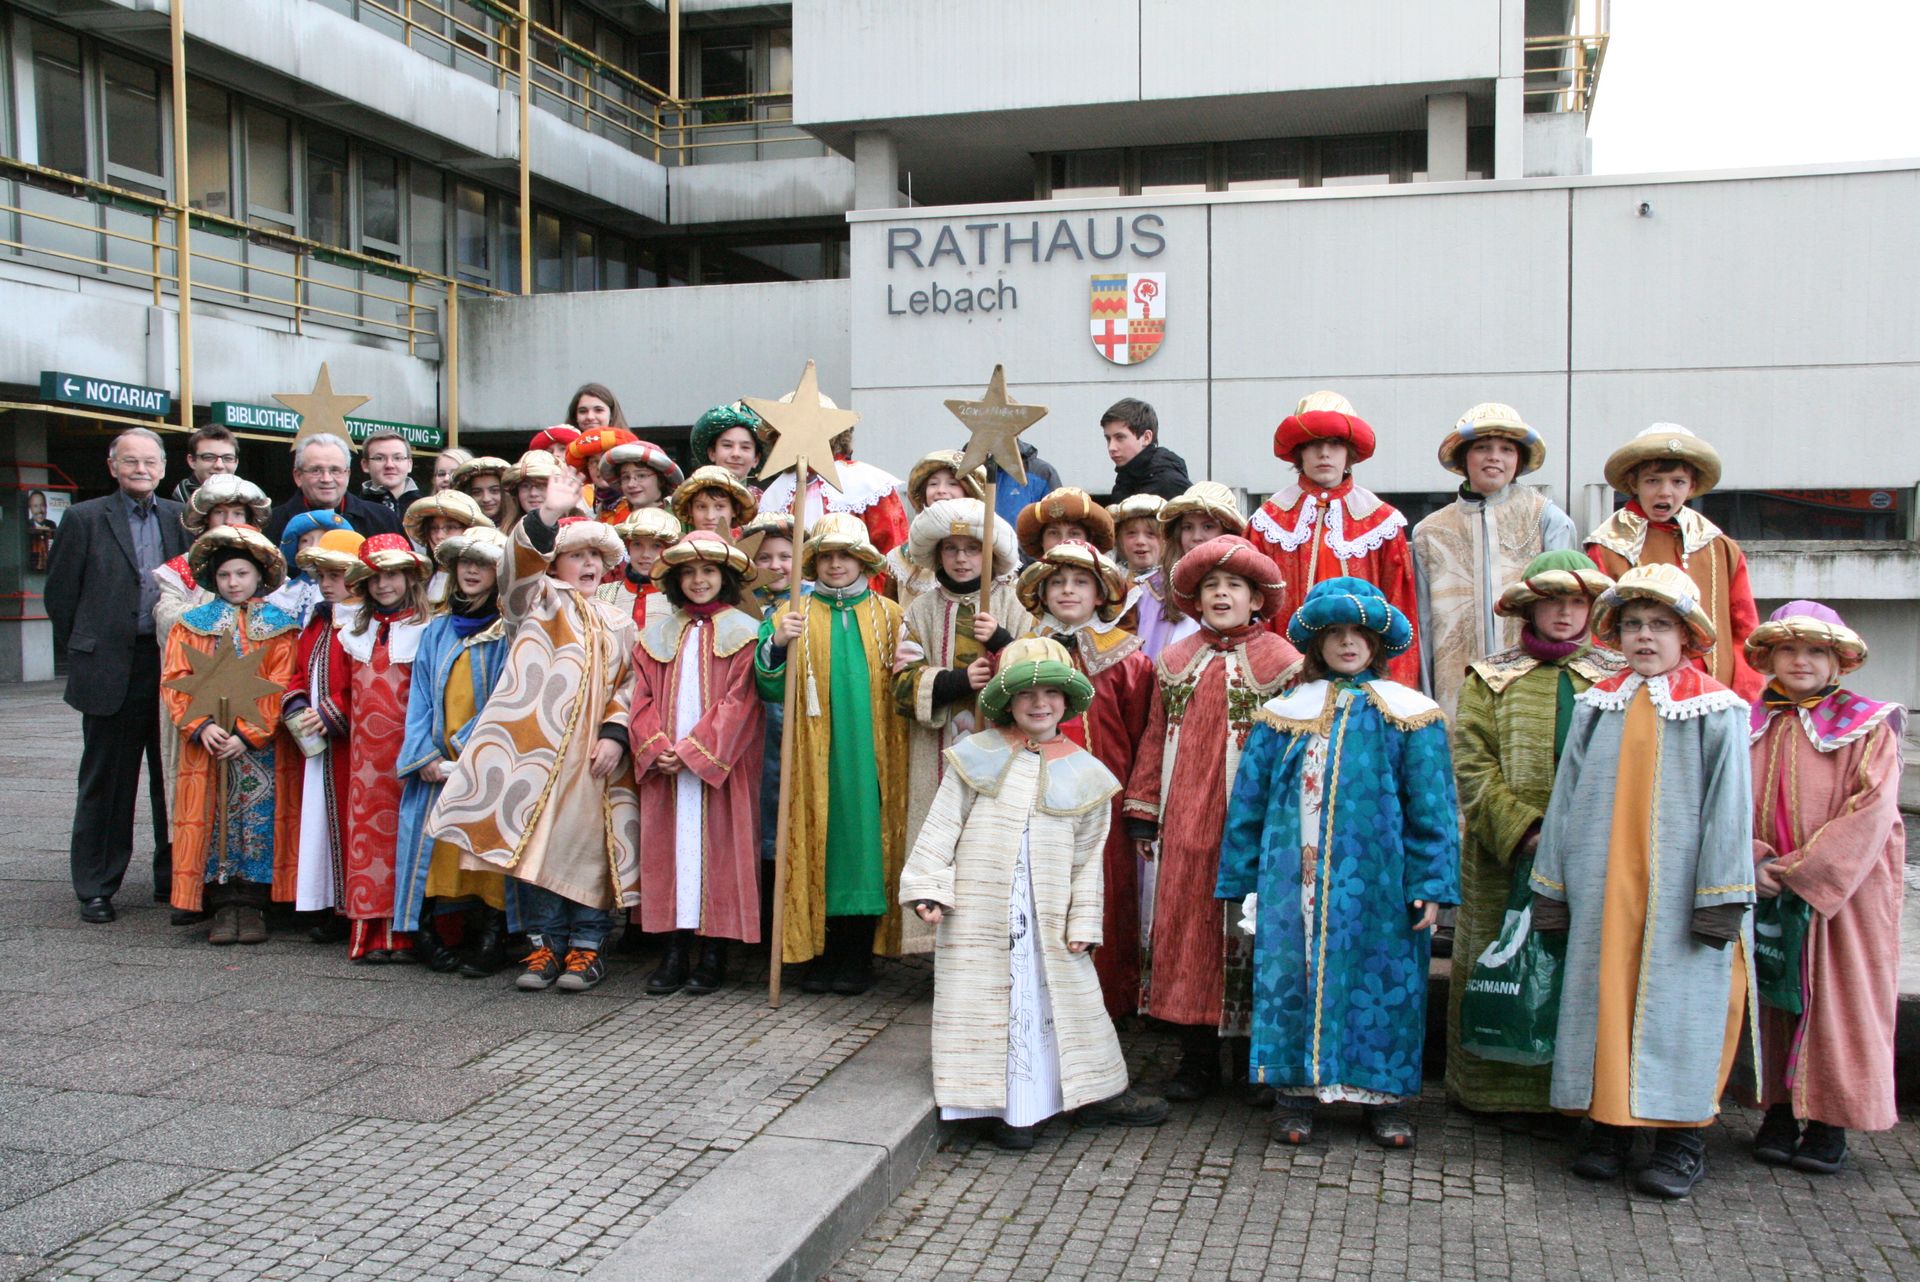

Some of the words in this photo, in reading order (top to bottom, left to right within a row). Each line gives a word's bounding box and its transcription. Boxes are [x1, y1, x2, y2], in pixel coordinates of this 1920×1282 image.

[887, 213, 1167, 269] RATHAUS
[887, 278, 1018, 316] Lebach
[86, 380, 164, 410] NOTARIAT
[226, 405, 300, 430] BIBLIOTHEK
